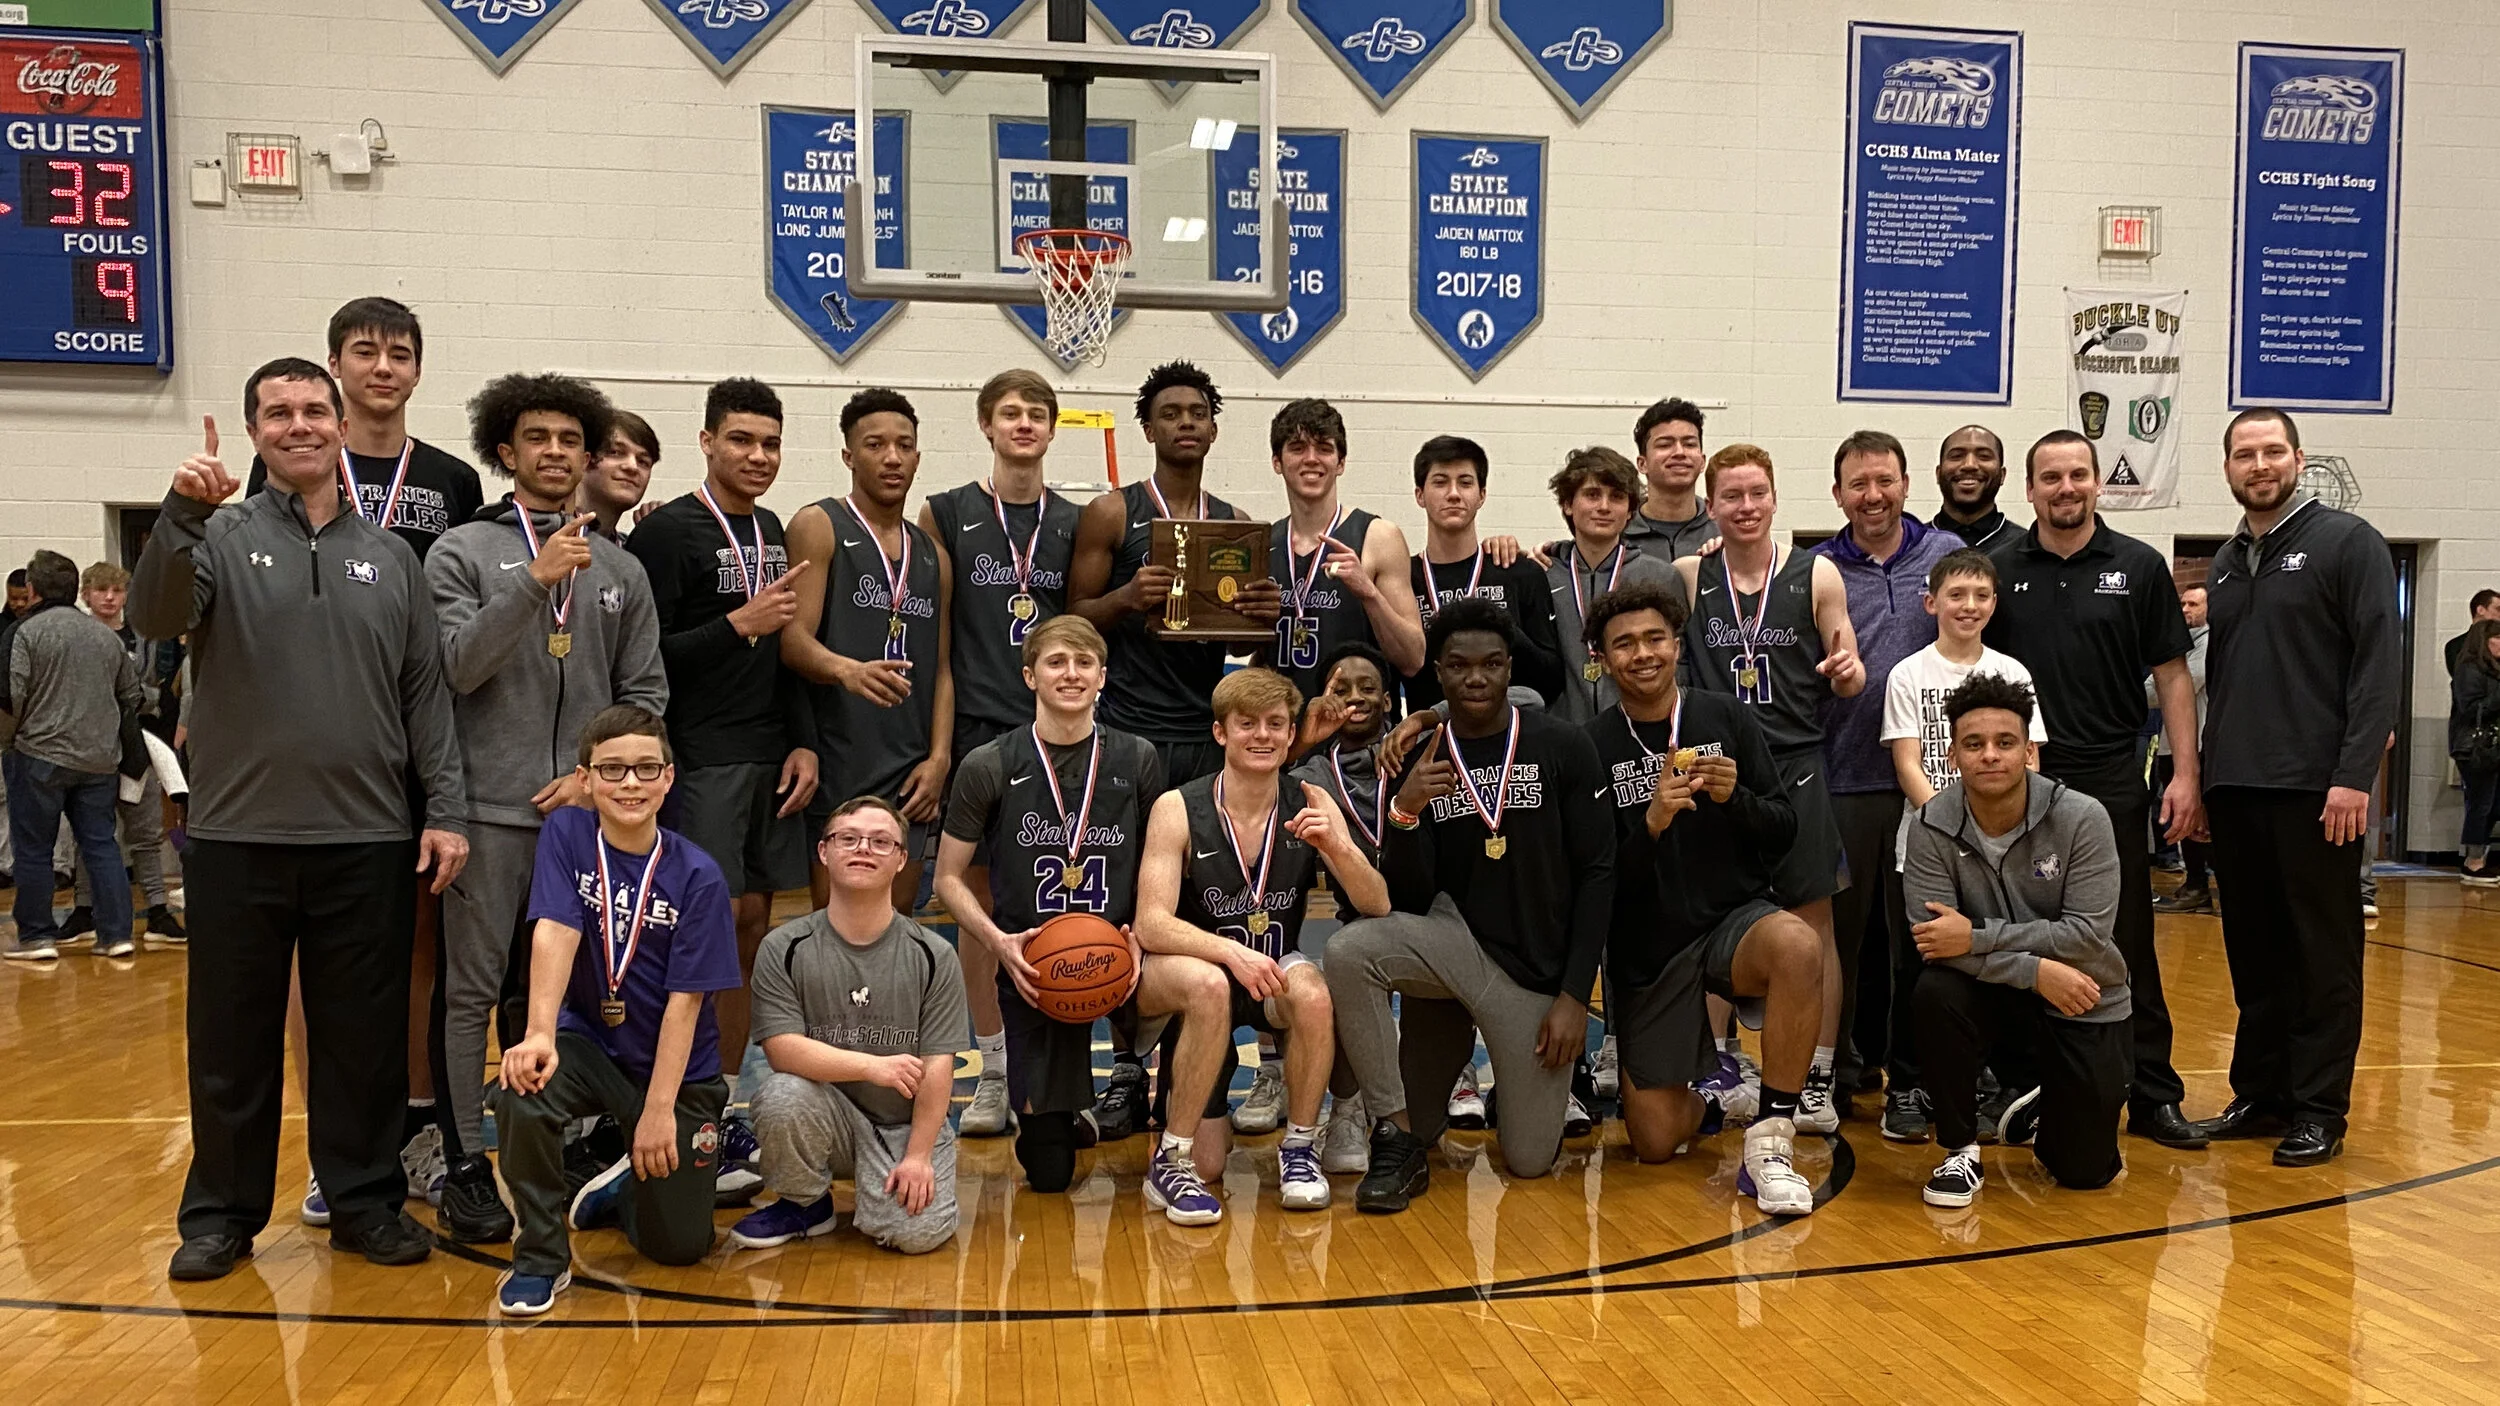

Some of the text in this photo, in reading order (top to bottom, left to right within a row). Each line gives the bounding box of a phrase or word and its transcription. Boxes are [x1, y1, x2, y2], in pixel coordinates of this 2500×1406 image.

[17, 60, 120, 96] Coca-Cola
[1874, 88, 1993, 128] COMETS
[6, 121, 141, 154] GUEST
[2262, 106, 2375, 143] COMETS
[248, 148, 286, 178] EXIT
[806, 151, 855, 170] STAT
[1865, 144, 2000, 164] CCHS Alma Mater
[784, 172, 892, 194] CHAMN
[1248, 168, 1308, 189] STE
[1450, 174, 1508, 194] STATE
[2259, 171, 2376, 191] CCHS Fight Song
[48, 160, 131, 227] 32
[1012, 182, 1116, 204] CHAON
[1228, 188, 1329, 212] CHPION
[1430, 194, 1528, 216] CHAMPION
[781, 204, 827, 220] TAYLOR
[776, 223, 810, 237] LONG
[815, 226, 845, 238] JUM
[1232, 222, 1324, 238] JADE ATTOX
[1435, 227, 1523, 243] JADEN MATTOX
[2114, 219, 2144, 244] EXIT
[63, 232, 148, 256] FOULS
[1460, 246, 1498, 259] 160 LB
[98, 262, 135, 322] 9
[1436, 271, 1521, 298] 2017-18
[2073, 303, 2180, 336] BUCKLE UP
[54, 331, 145, 353] SCORE
[357, 484, 443, 508] FRNCIS
[363, 502, 448, 534] SLES
[717, 564, 788, 593] DESL
[970, 554, 1063, 589] Stalons
[853, 574, 933, 618] Staions
[1268, 576, 1341, 609] allons
[1438, 586, 1504, 605] RACIS
[1008, 593, 1038, 646] 2
[1276, 616, 1319, 668] 15
[1730, 654, 1772, 704] 11
[1922, 706, 1948, 723] ALLE
[1470, 764, 1539, 785] RACIS
[1612, 742, 1723, 781] ST. FRCIS
[1430, 783, 1542, 822] DESAES
[575, 870, 679, 925] EAES
[1034, 855, 1109, 913] 24
[1203, 887, 1298, 918] Stallons
[1051, 951, 1117, 980] Rawlings
[1056, 992, 1119, 1012] OHSAA
